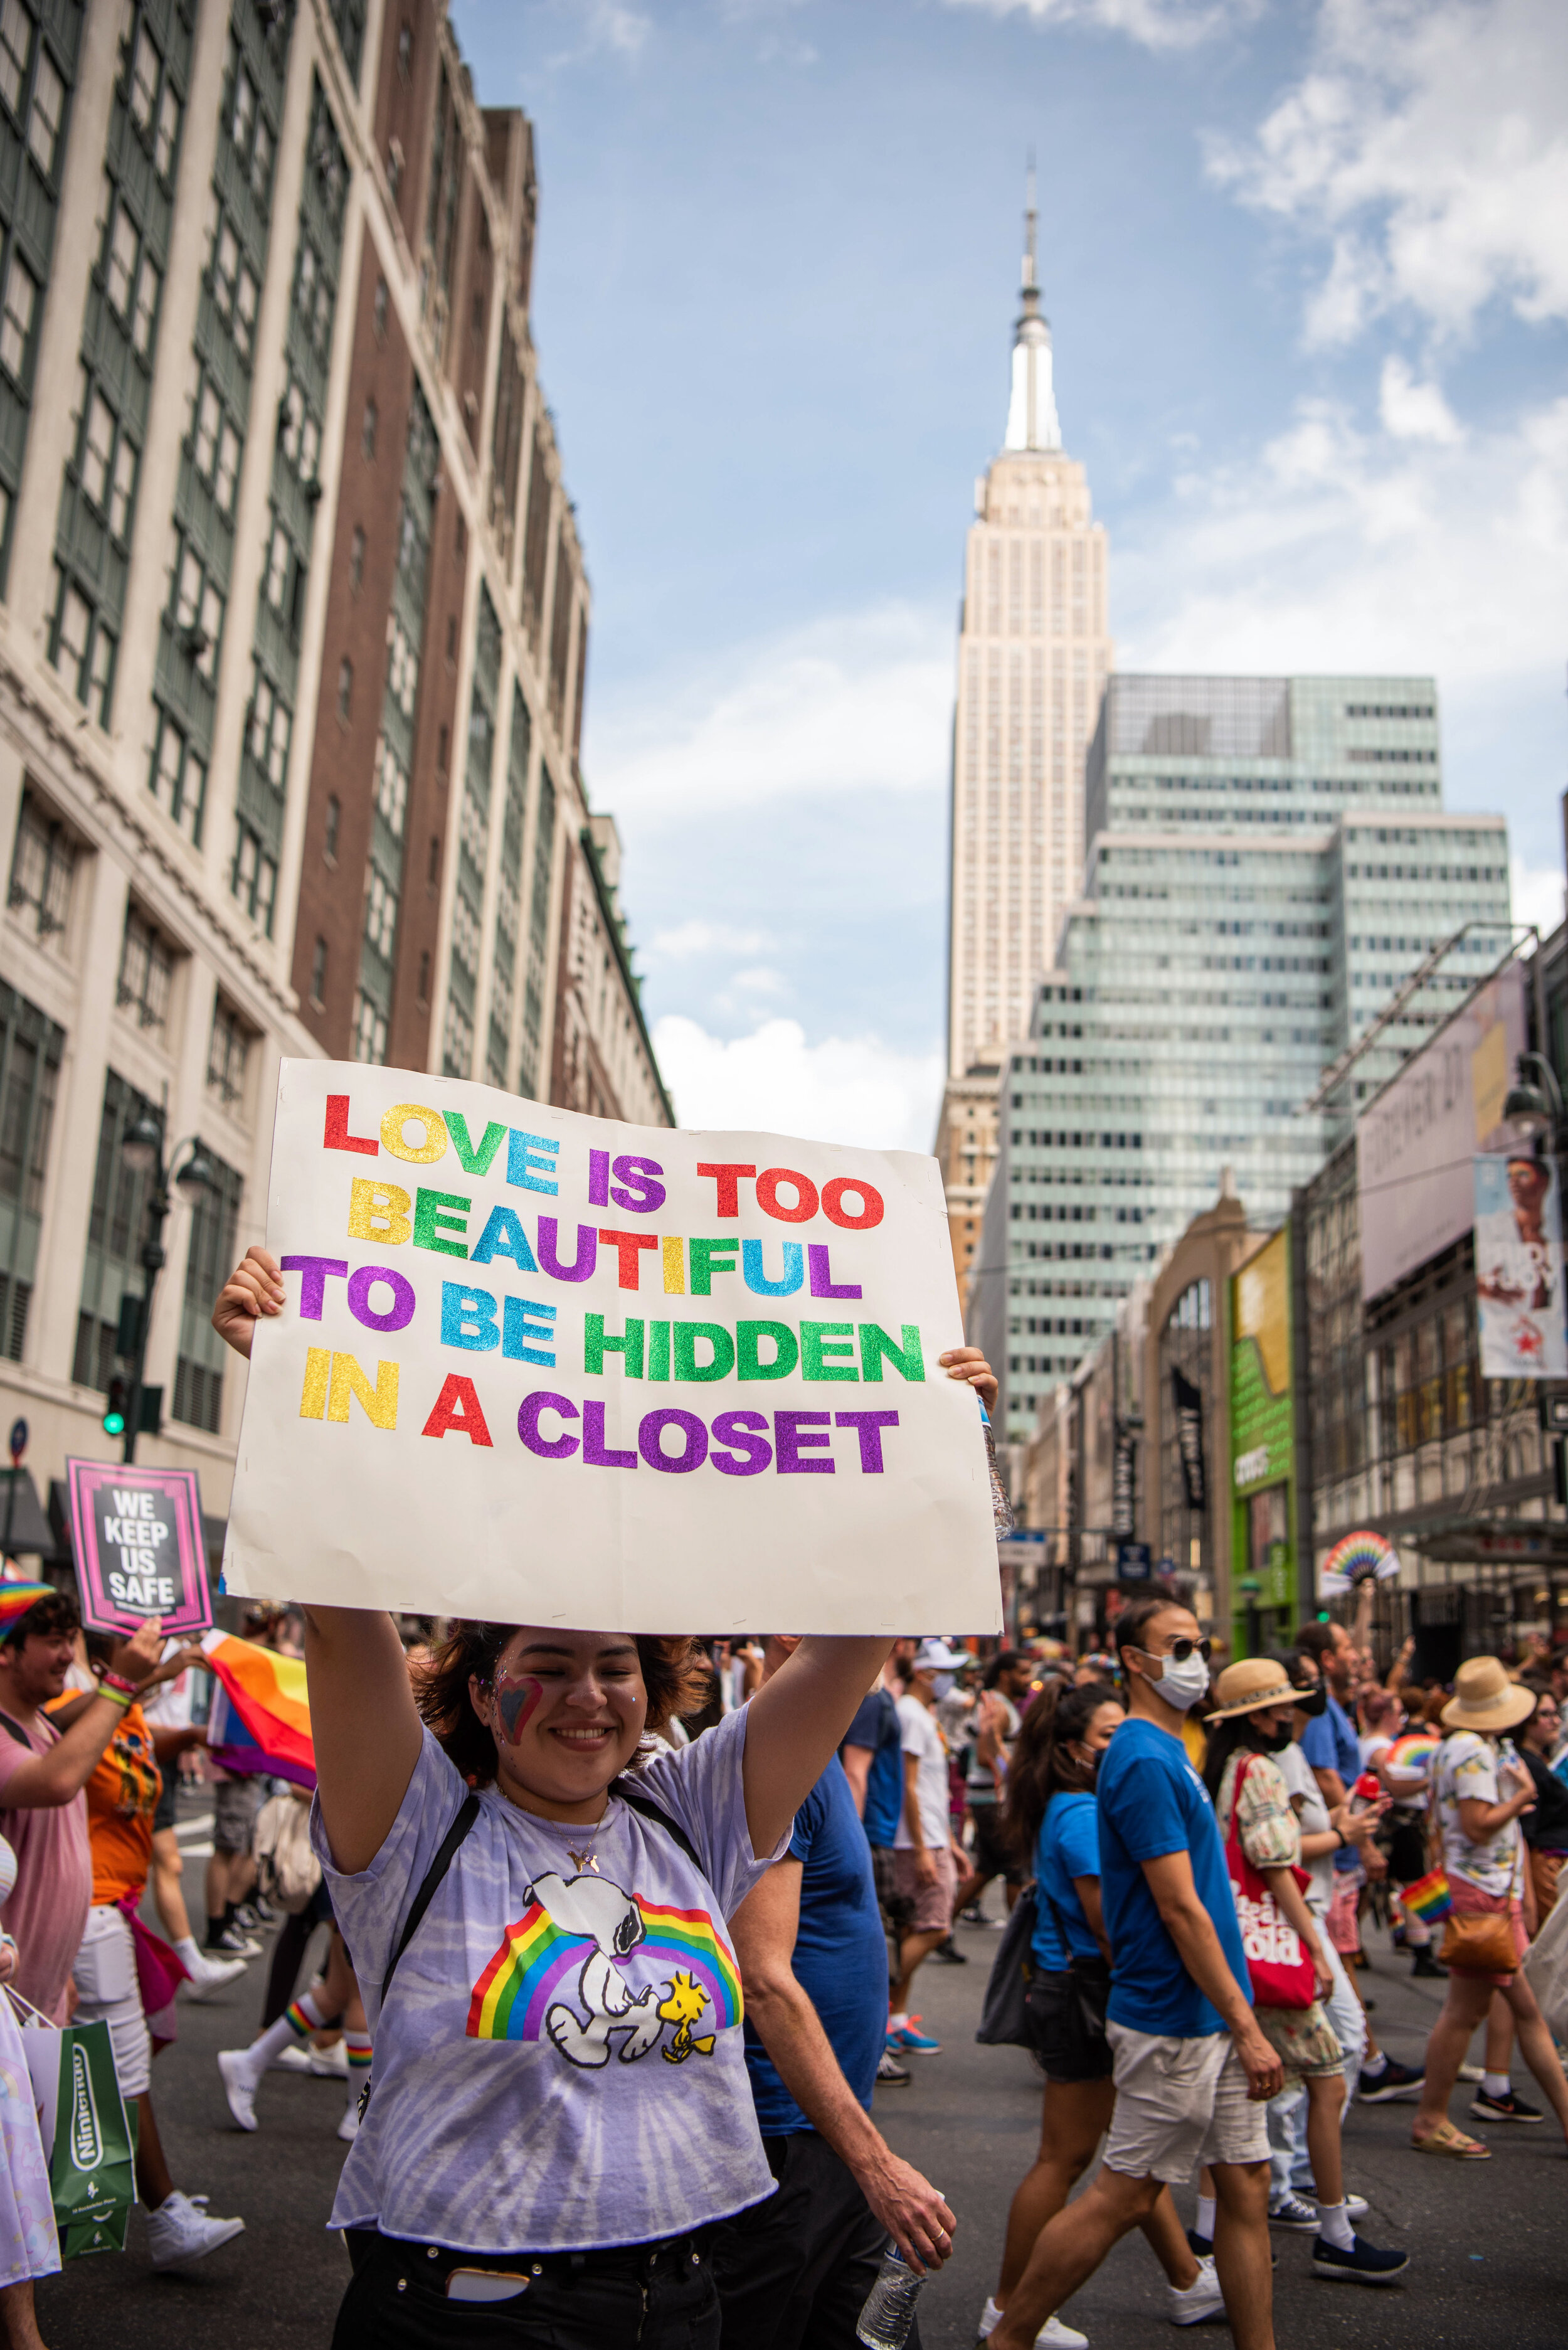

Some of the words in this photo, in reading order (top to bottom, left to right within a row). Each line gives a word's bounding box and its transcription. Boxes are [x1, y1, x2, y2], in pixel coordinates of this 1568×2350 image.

[324, 1095, 559, 1196] LOVE
[588, 1149, 666, 1213] IS
[697, 1162, 884, 1230] TOO
[347, 1177, 862, 1299] BEAUTIFUL
[280, 1255, 416, 1332] TO
[440, 1281, 557, 1368] BE
[585, 1312, 925, 1382] HIDDEN
[299, 1347, 400, 1430] IN
[421, 1373, 493, 1447] A
[517, 1391, 899, 1476] CLOSET
[104, 1516, 169, 1548] KEEP
[113, 1489, 156, 1519] WE
[109, 1572, 175, 1605] SAFE
[120, 1546, 157, 1576] US
